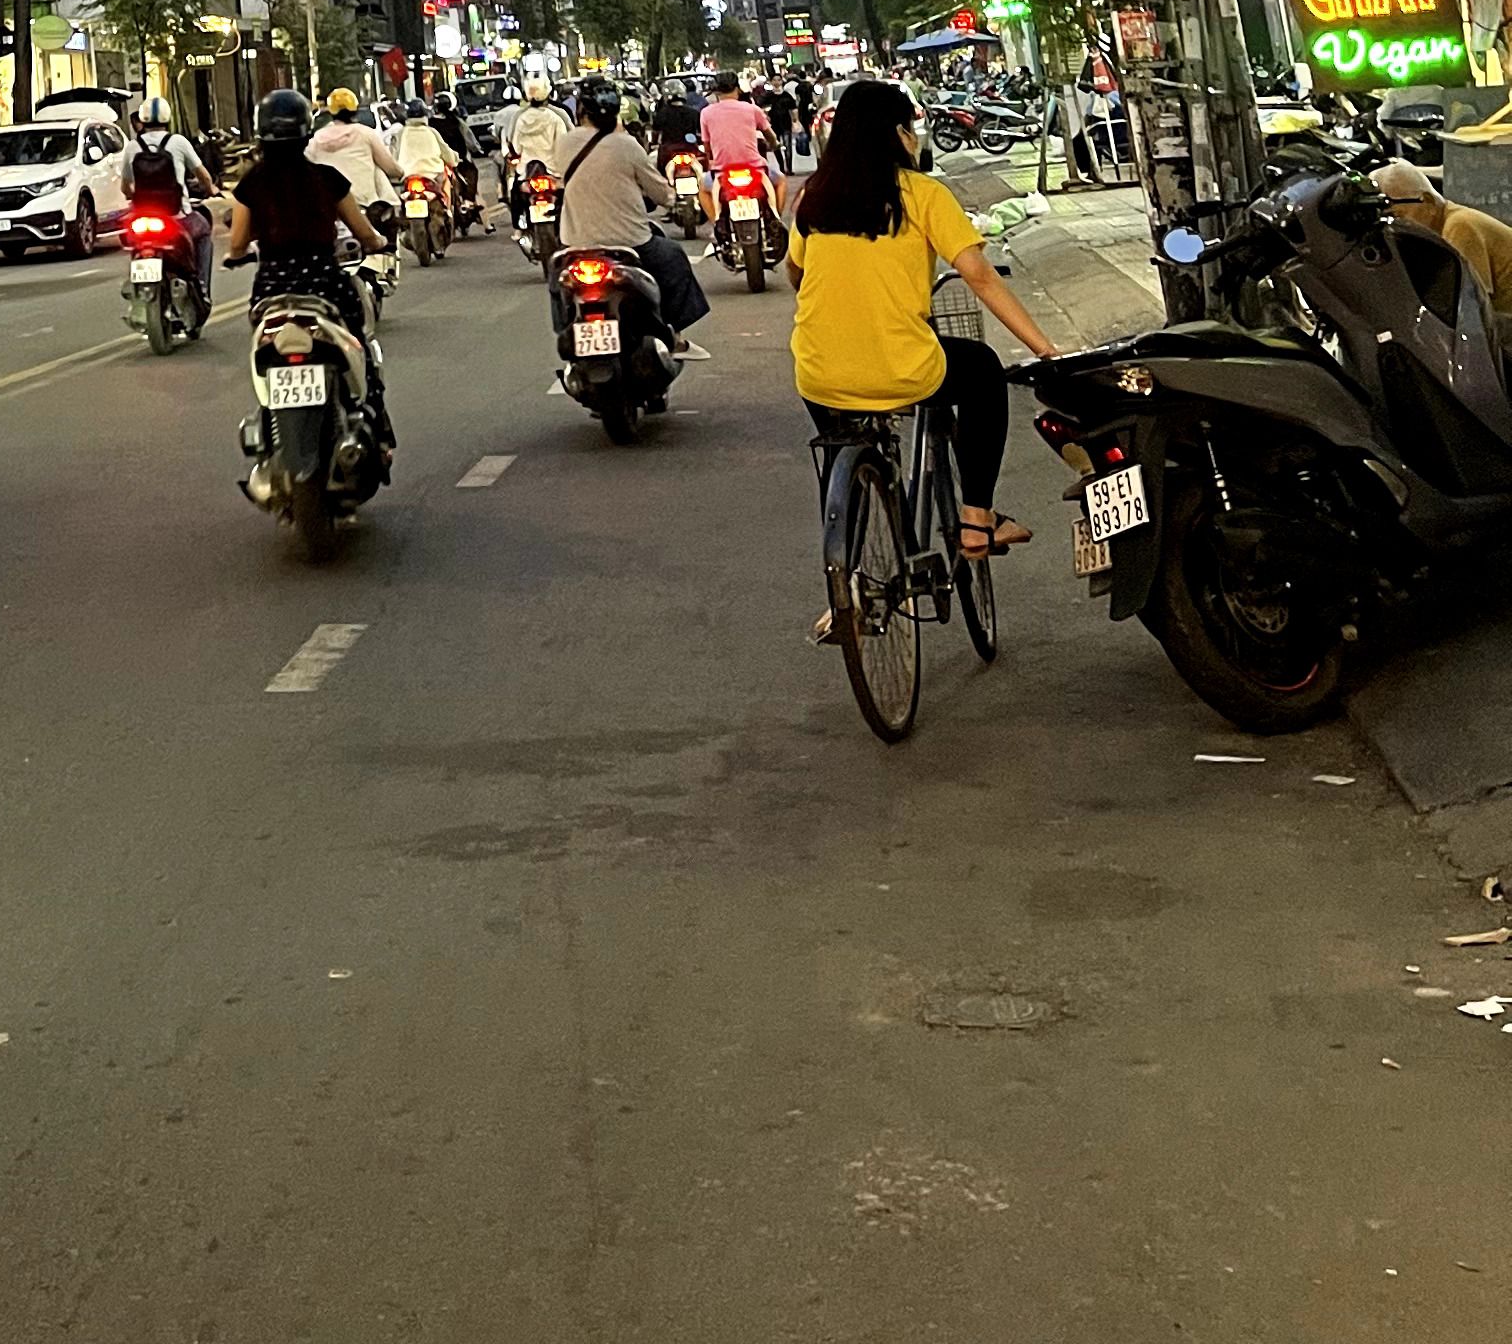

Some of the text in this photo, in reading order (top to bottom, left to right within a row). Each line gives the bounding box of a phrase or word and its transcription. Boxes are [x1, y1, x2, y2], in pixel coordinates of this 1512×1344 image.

[1311, 28, 1463, 80] Vegan
[276, 367, 315, 387] 59-F1
[1092, 496, 1145, 538] 893.78
